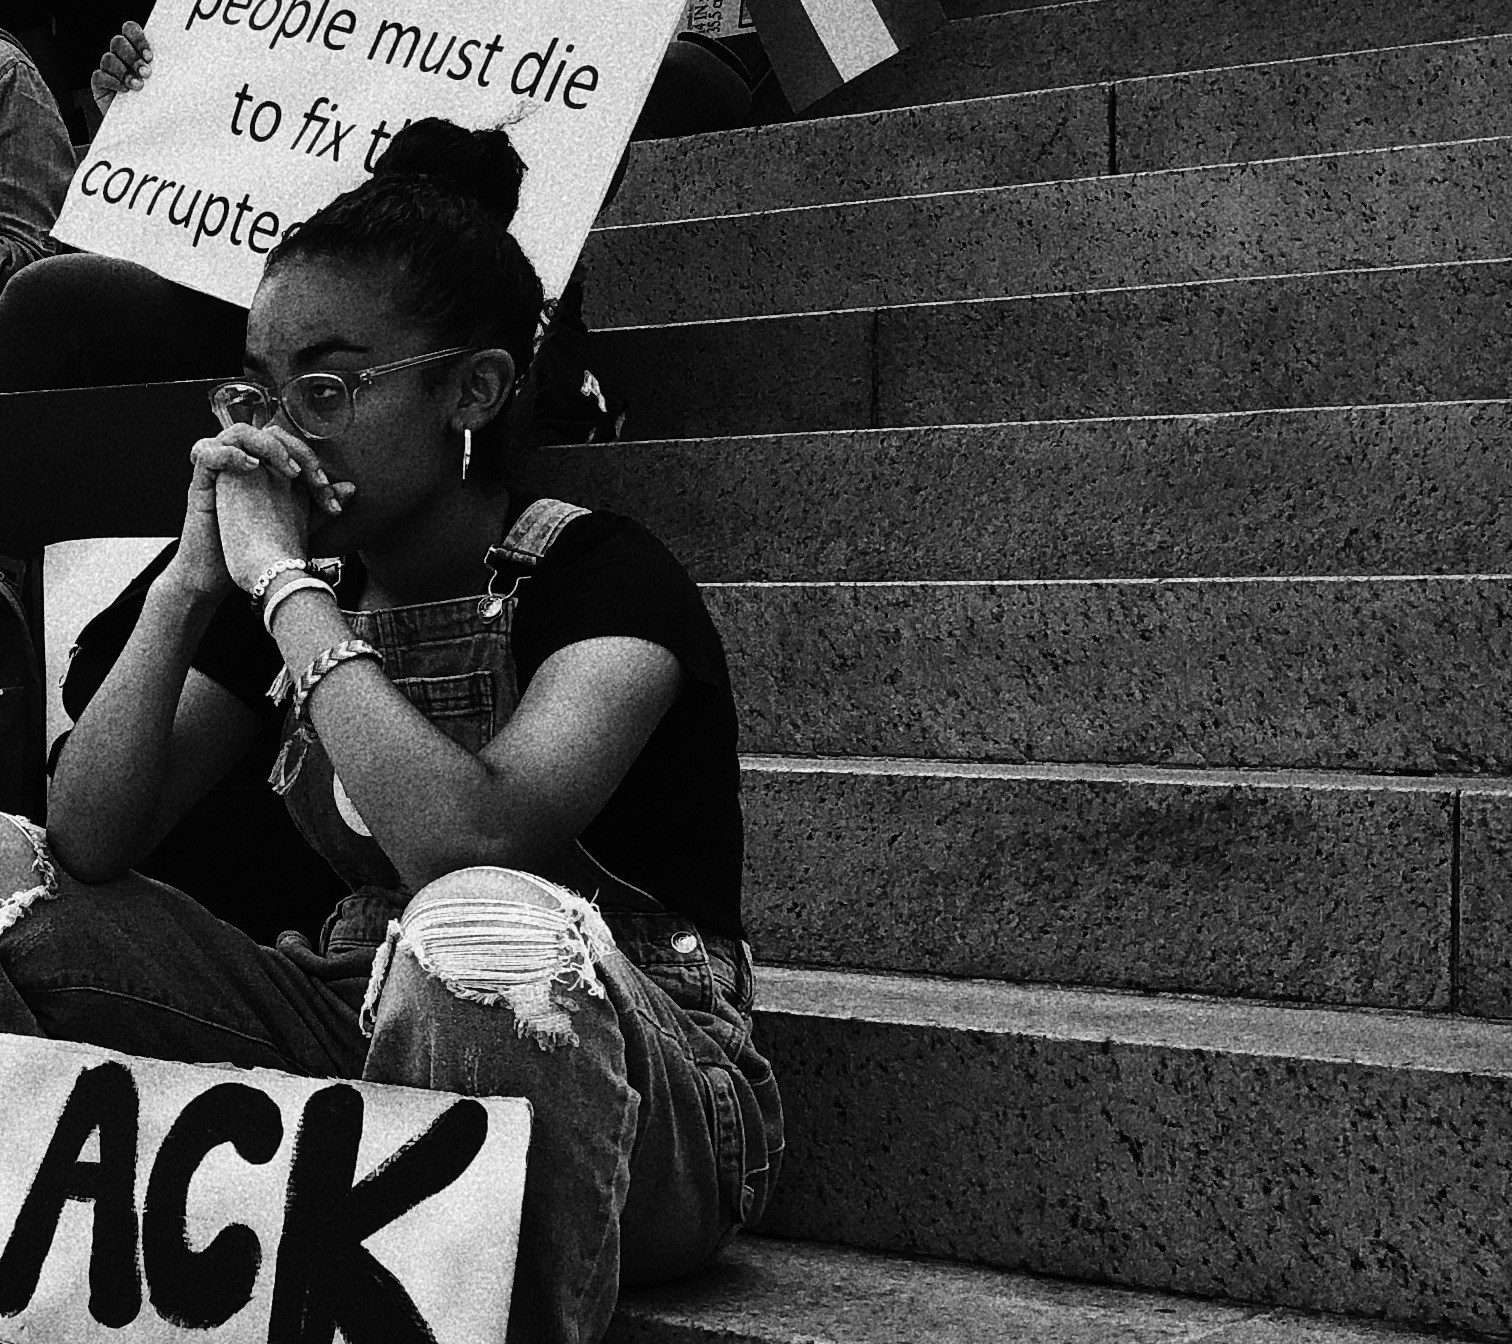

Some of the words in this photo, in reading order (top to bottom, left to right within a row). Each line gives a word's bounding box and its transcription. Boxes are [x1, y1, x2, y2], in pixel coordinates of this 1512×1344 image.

[368, 19, 505, 88] must
[510, 37, 600, 110] die
[229, 83, 282, 144] to
[290, 97, 357, 162] fix
